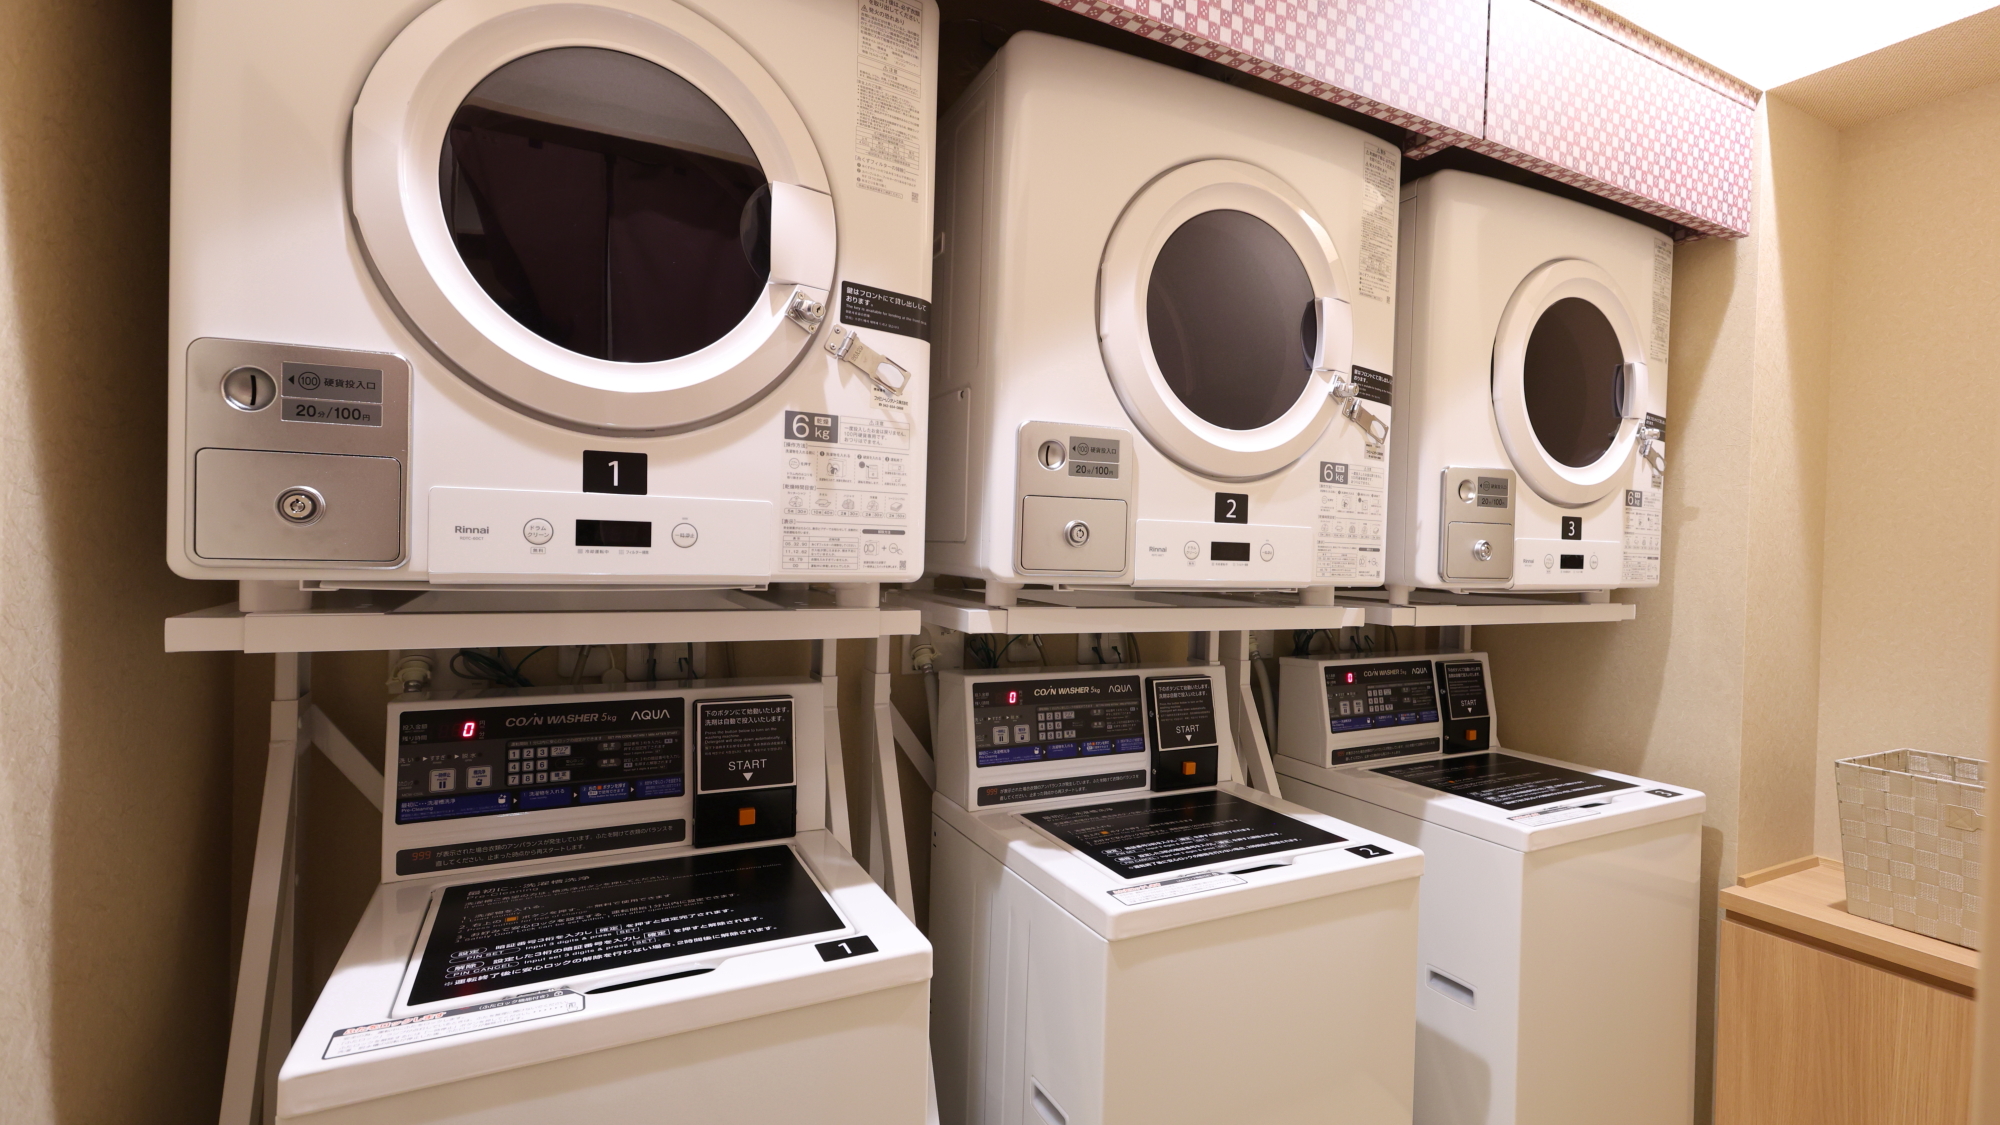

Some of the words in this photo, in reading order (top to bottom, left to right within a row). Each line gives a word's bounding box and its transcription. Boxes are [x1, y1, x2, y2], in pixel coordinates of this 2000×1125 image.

[846, 295, 874, 307] おります。
[301, 377, 318, 386] 100
[324, 378, 375, 390] 硬貨投入口
[296, 405, 370, 421] 20分/100円
[793, 415, 809, 438] 6
[815, 427, 830, 440] kg
[608, 461, 619, 486] 1
[1324, 464, 1333, 481] 6
[1336, 474, 1344, 482] kg
[1628, 492, 1634, 505] 6
[1226, 499, 1237, 518] 2
[455, 525, 489, 535] Rinnai
[1568, 521, 1575, 536] 3
[1379, 667, 1399, 675] WASHER
[1348, 673, 1353, 683] 0
[1058, 687, 1089, 695] WASHER
[1109, 684, 1132, 693] AQUA
[1009, 692, 1016, 703] 0
[704, 705, 789, 717] 下のボタンにて始動いたします。
[506, 713, 543, 727] COIN
[547, 713, 599, 725] WASHER
[601, 712, 617, 722] 5kg
[631, 709, 670, 721] AQUA
[704, 714, 785, 726] 洗剤は自動で投入いたします。
[462, 722, 475, 737] 0
[1176, 725, 1200, 734] START
[728, 758, 767, 771] START
[411, 850, 431, 861] 999
[1358, 848, 1379, 856] 2
[494, 929, 592, 950] 暗証番号3桁を入力し
[625, 907, 734, 928] を押すと設定完了されます。
[672, 914, 764, 934] を押すと解除されます。
[838, 943, 853, 955] 1
[473, 962, 512, 973] CANCEL
[605, 942, 628, 950] press
